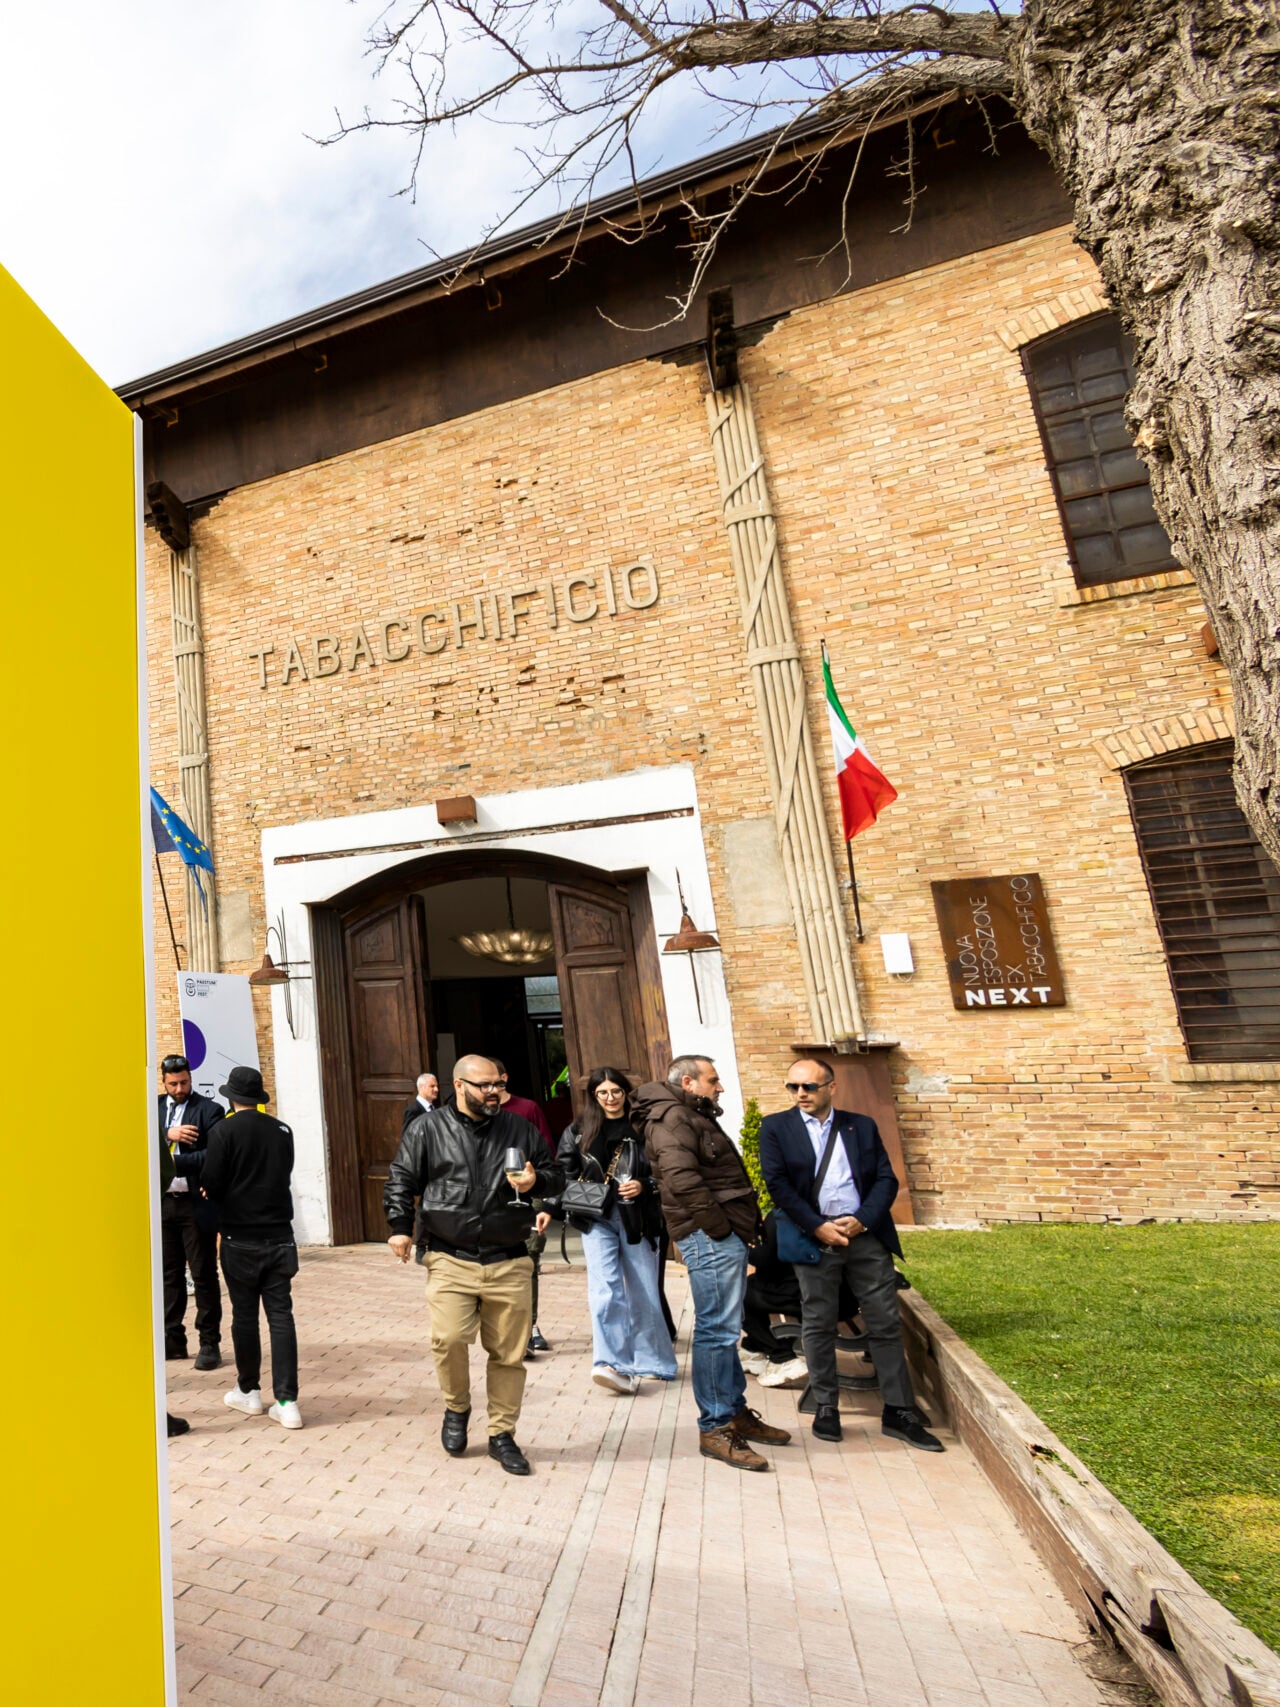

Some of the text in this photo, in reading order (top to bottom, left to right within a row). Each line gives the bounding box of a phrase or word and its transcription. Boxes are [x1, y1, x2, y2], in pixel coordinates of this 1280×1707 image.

[248, 560, 660, 690] TABACCHIFICIO
[956, 933, 982, 986] NUOVA
[970, 895, 1004, 985] ESPOSIZIONE
[1010, 876, 1048, 982] TABACCHIFICIO
[964, 986, 1052, 1006] NEXT
[1005, 964, 1026, 984] EX
